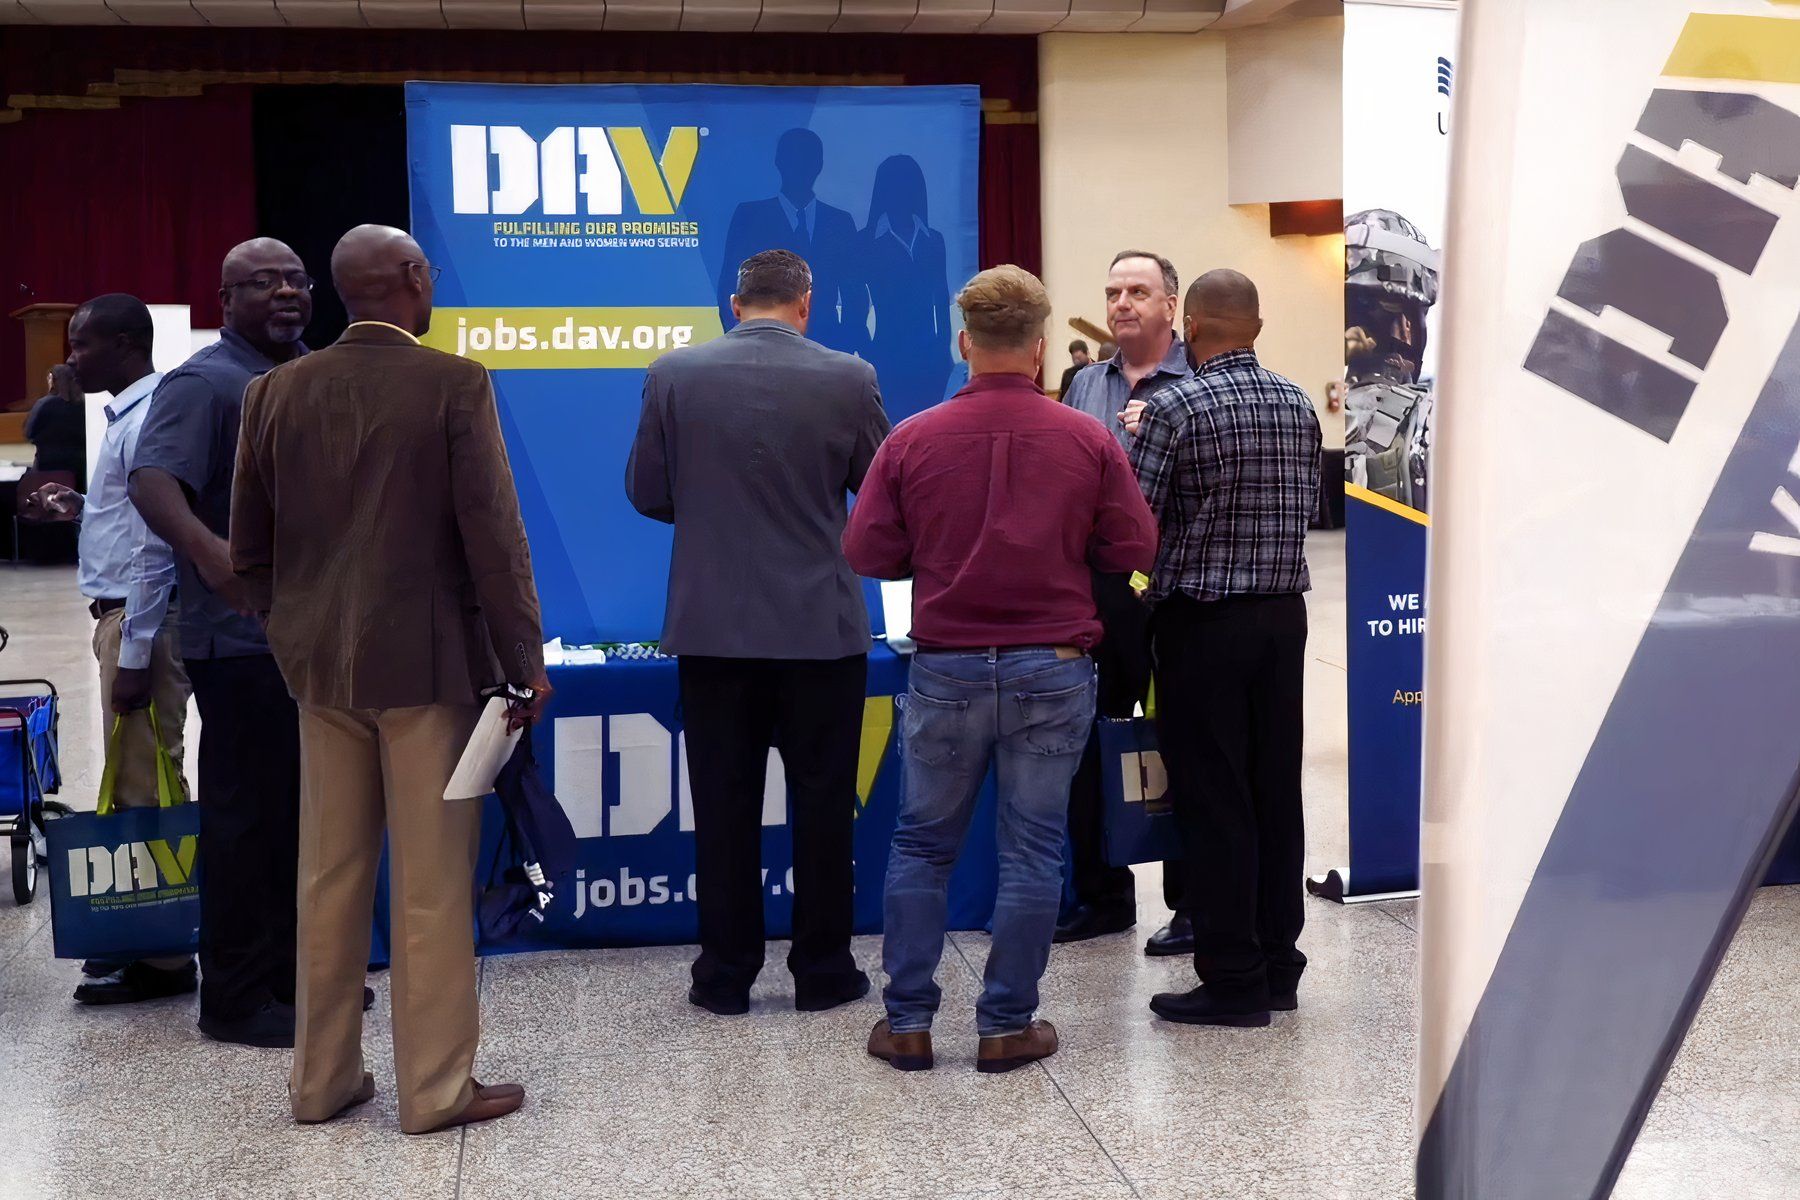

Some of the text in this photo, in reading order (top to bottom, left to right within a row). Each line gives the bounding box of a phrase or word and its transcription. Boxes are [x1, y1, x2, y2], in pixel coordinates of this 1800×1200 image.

[450, 124, 699, 215] DAV
[585, 221, 618, 235] OUR
[621, 221, 699, 235] PROMISES
[493, 237, 699, 248] TO THE MEN AND WOMEN WHO SERVED
[455, 316, 693, 357] jobs.dav.org
[1388, 593, 1420, 611] WE
[1367, 617, 1427, 637] TO HIR
[1392, 688, 1424, 706] App
[68, 834, 197, 897] DAV
